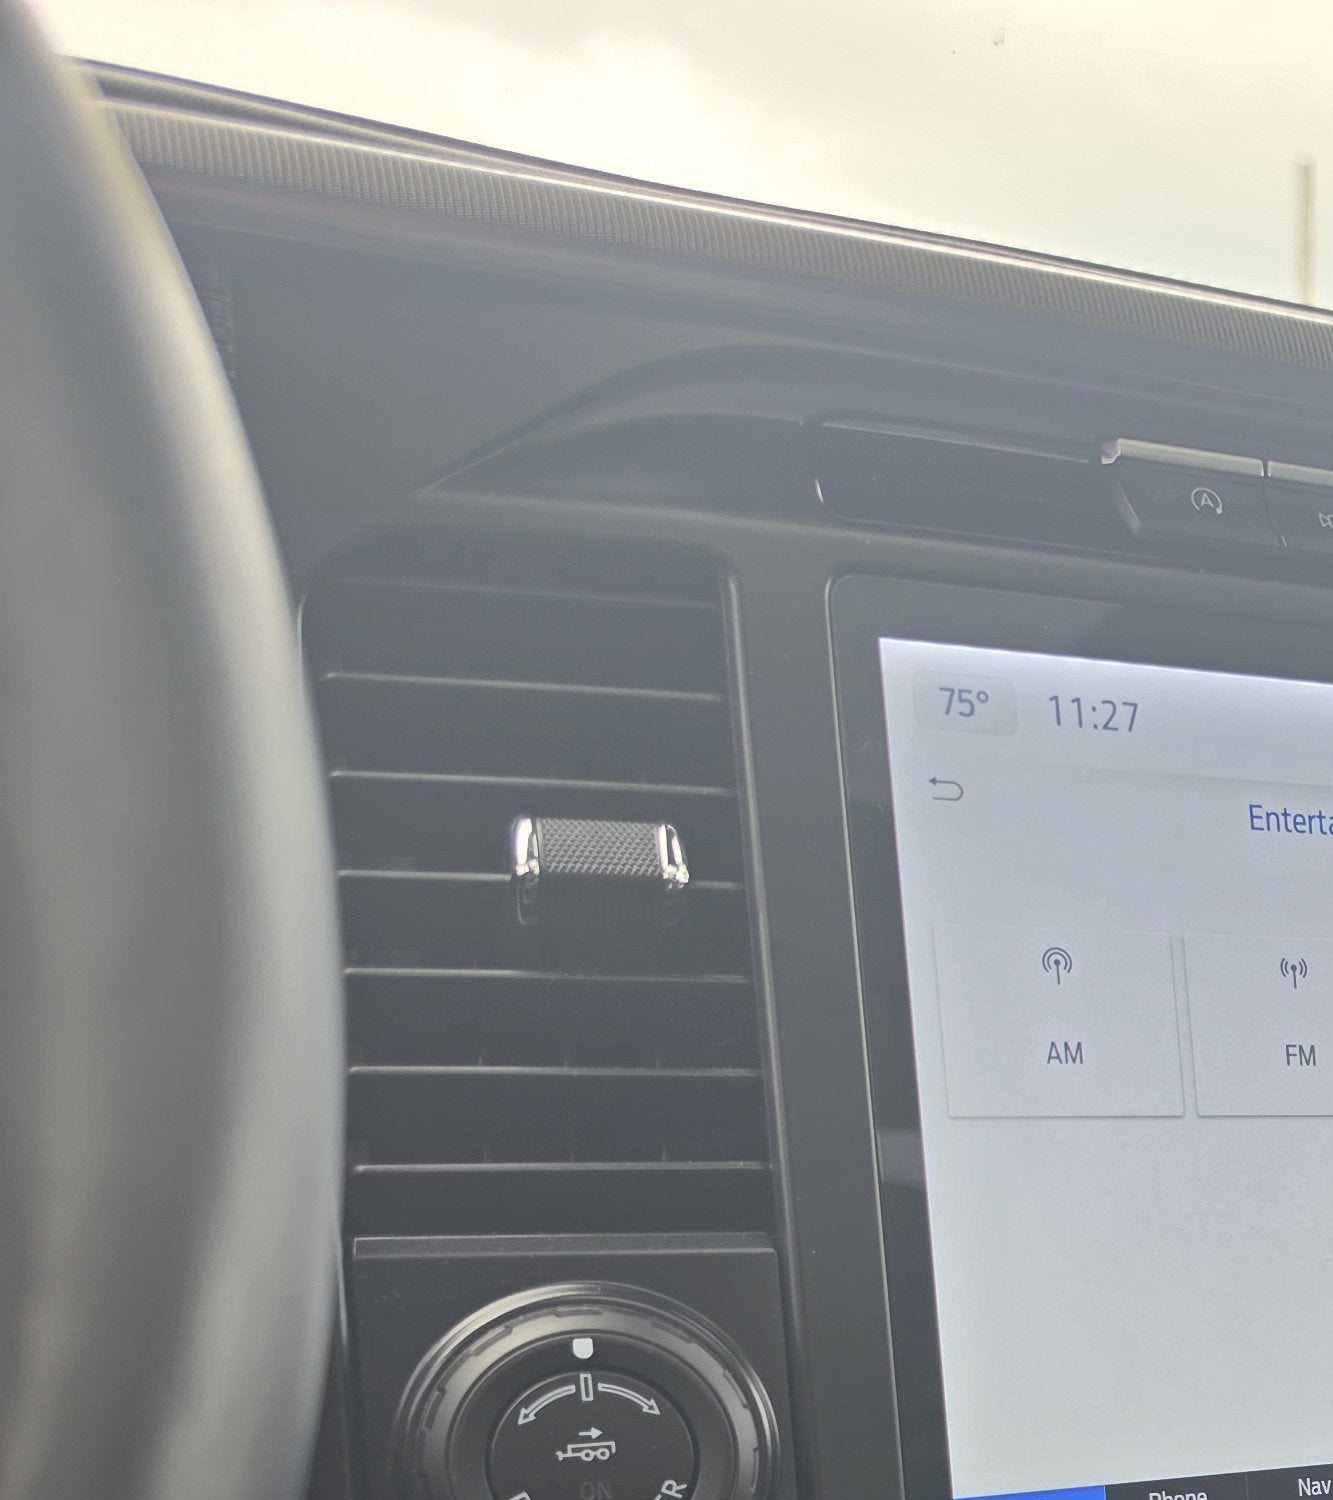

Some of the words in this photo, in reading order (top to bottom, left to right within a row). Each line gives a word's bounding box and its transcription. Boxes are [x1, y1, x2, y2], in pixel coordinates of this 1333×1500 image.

[939, 686, 989, 718] 75°
[1049, 695, 1138, 733] 11:27
[1046, 1041, 1084, 1065] AM
[1285, 1044, 1317, 1067] FM
[1297, 1477, 1332, 1497] Nav
